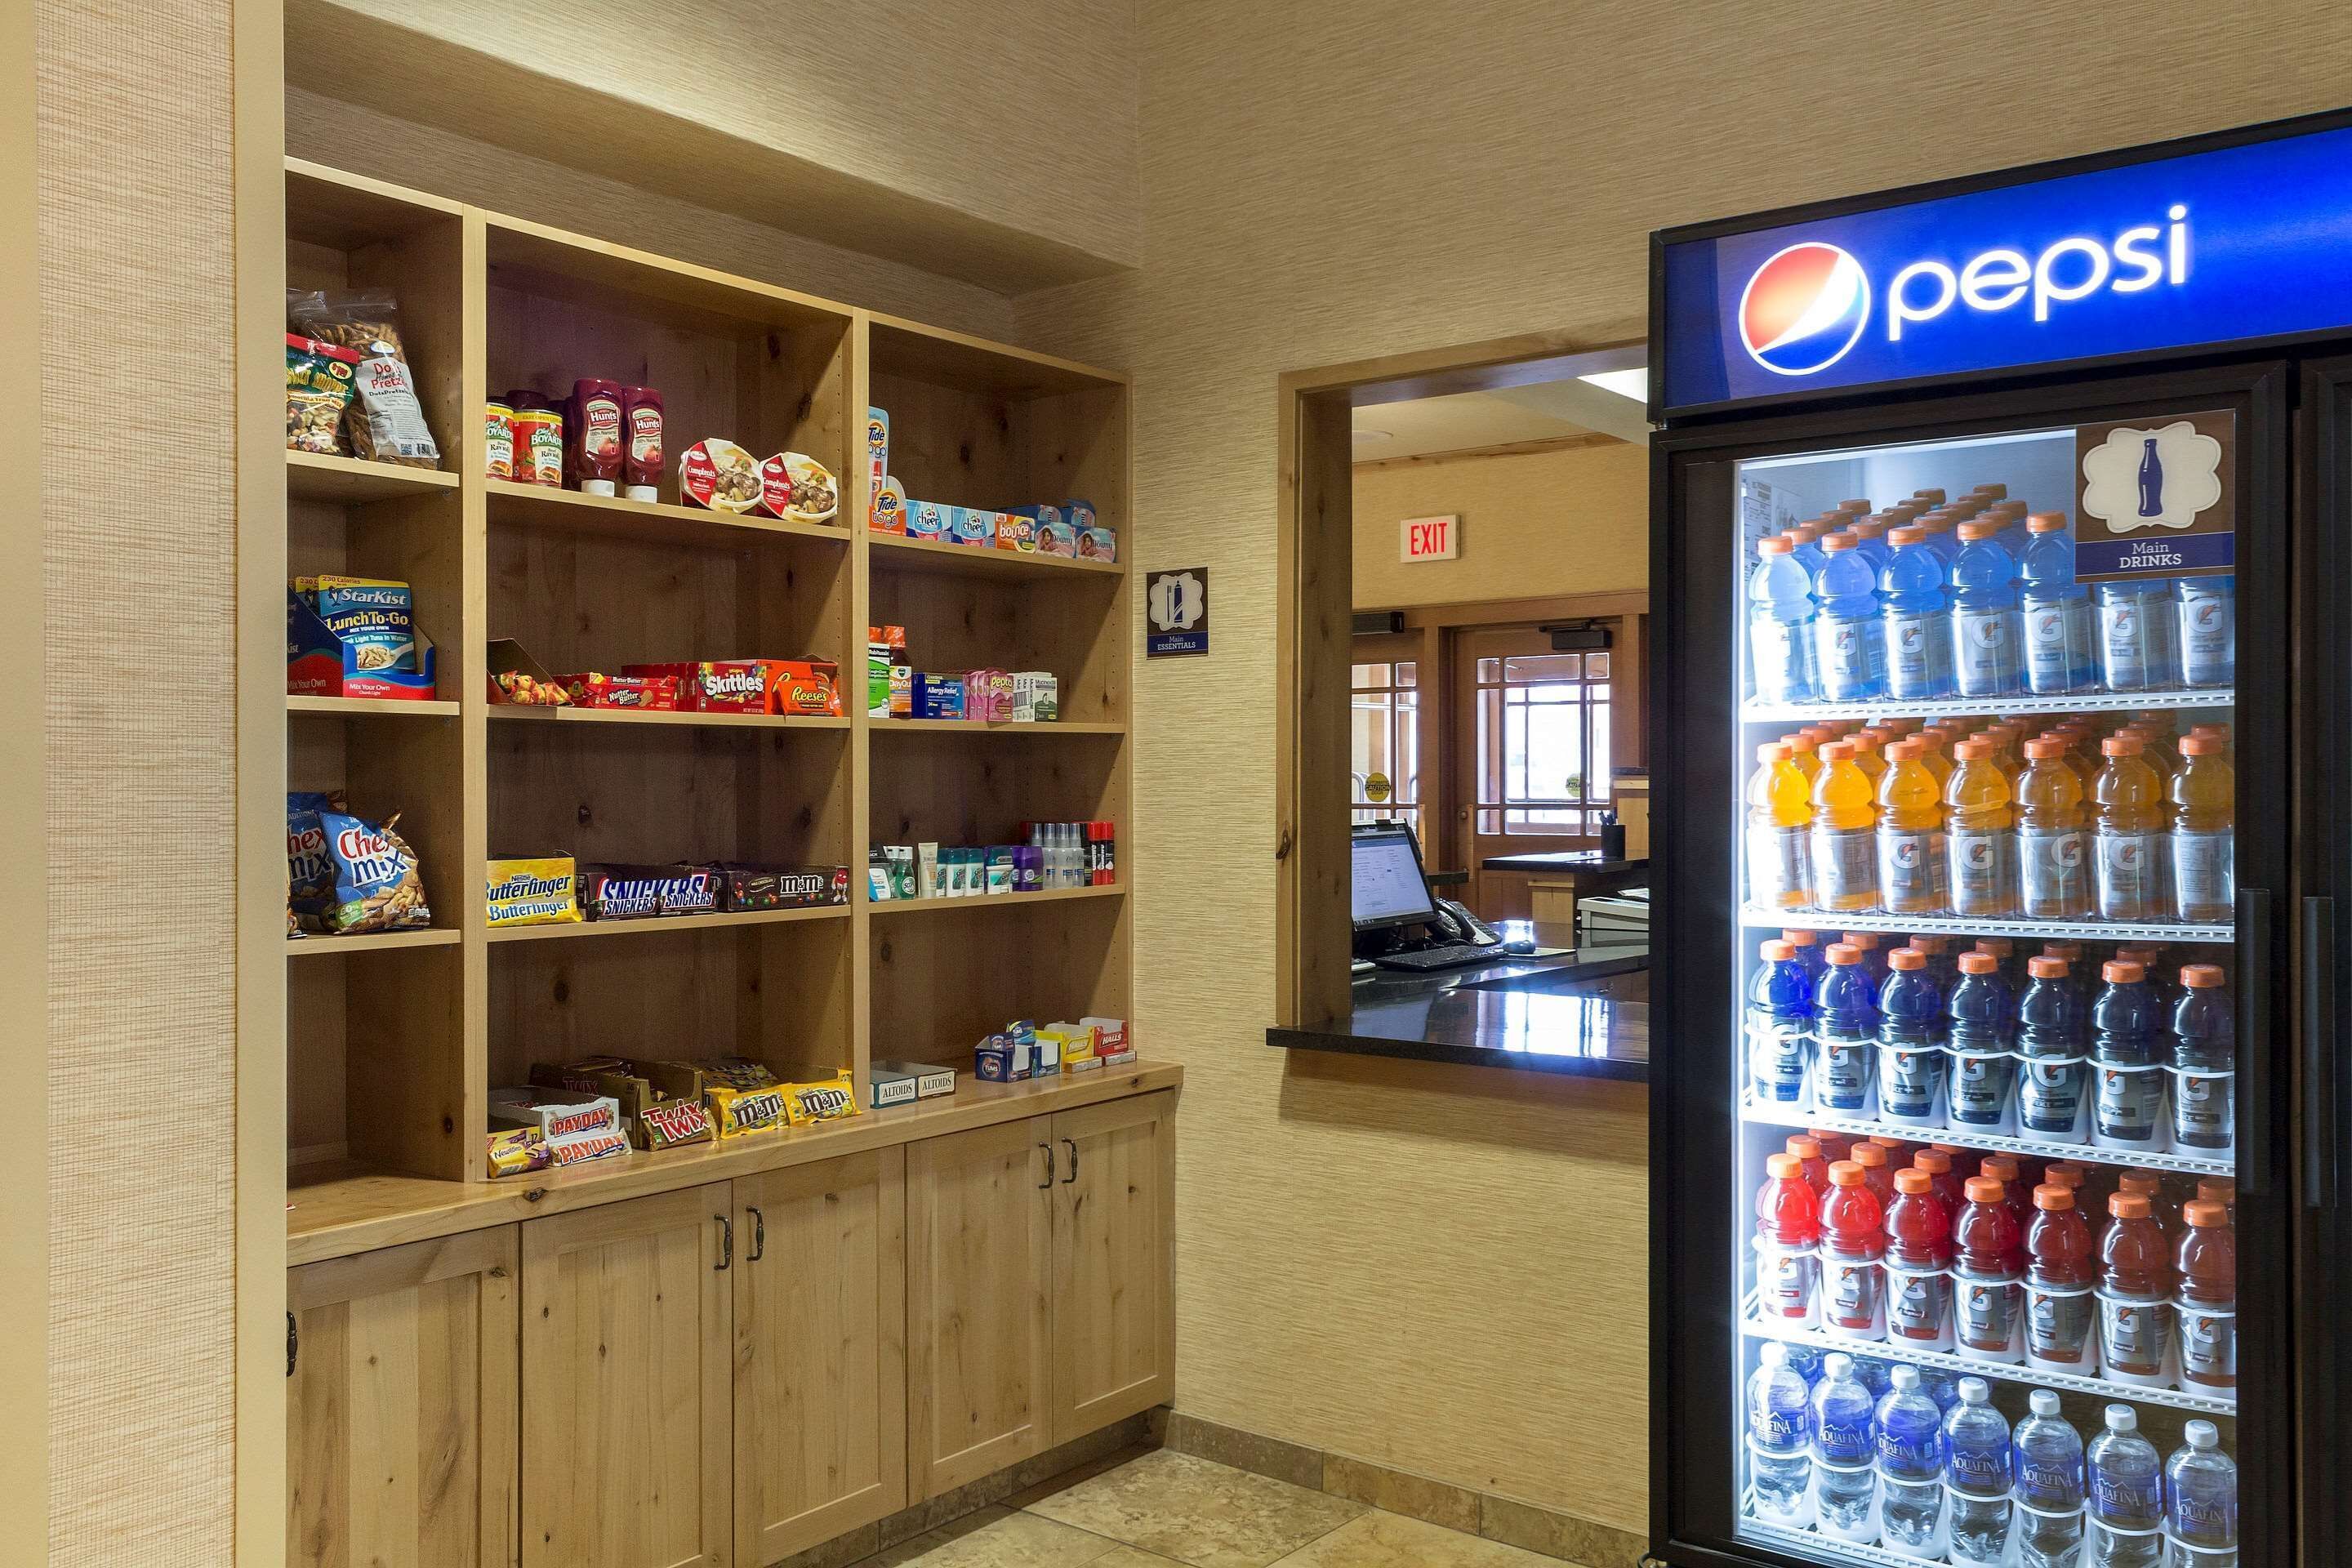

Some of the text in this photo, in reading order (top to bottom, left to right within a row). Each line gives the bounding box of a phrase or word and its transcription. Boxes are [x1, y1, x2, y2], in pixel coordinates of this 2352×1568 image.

[1888, 204, 2187, 342] pepsi
[868, 426, 884, 442] Tide
[877, 496, 898, 512] Tide
[916, 510, 939, 527] cheer
[962, 517, 984, 532] cheer
[1410, 523, 1447, 555] EXIT
[2132, 541, 2169, 555] Main
[2119, 554, 2182, 568] DRINKS
[337, 577, 360, 585] Calories
[341, 588, 406, 605] StarKist
[326, 612, 368, 631] Lunch
[1157, 641, 1196, 651] ESSENTIALS
[706, 673, 764, 696] Skittles
[927, 687, 944, 696] Allergy
[791, 686, 828, 701] Reese's
[287, 830, 323, 855] hex
[354, 850, 406, 884] mix
[604, 875, 704, 899] SNICKERS
[605, 899, 654, 915] SNICKERS
[666, 893, 712, 906] SNICKERS
[1102, 1032, 1123, 1045] HALLS
[882, 1084, 912, 1098] ALTOIDS
[922, 1077, 951, 1091] ALTOIDS
[554, 1107, 608, 1137] PAYDAY
[559, 1136, 625, 1163] PAYDAY
[1820, 1429, 1864, 1444] AQUAFINA
[1952, 1457, 2000, 1473] AQUAFINA
[2022, 1469, 2072, 1487] AQUAFINA
